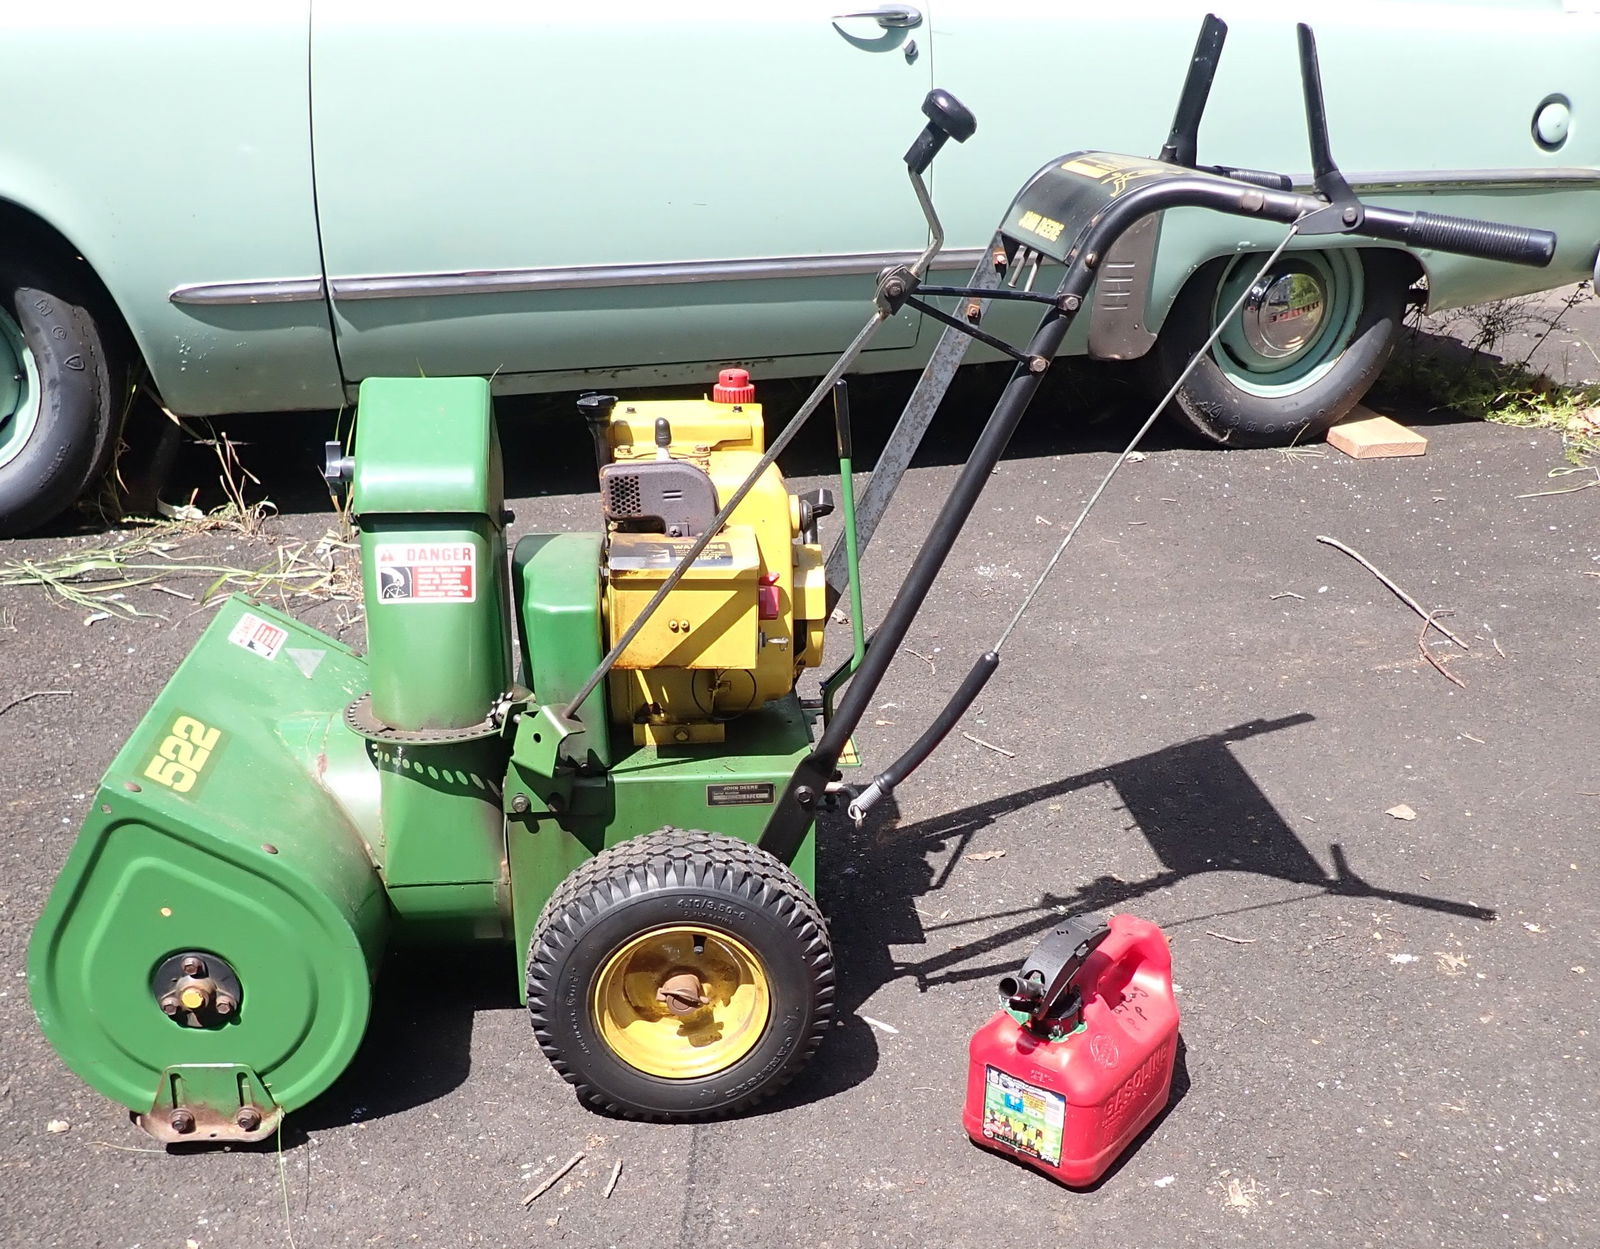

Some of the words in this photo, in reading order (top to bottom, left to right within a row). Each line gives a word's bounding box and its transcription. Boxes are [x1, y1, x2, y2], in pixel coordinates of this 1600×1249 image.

[407, 547, 471, 561] DANGER
[143, 715, 222, 793] 522
[1104, 1044, 1169, 1119] GASOLINE
